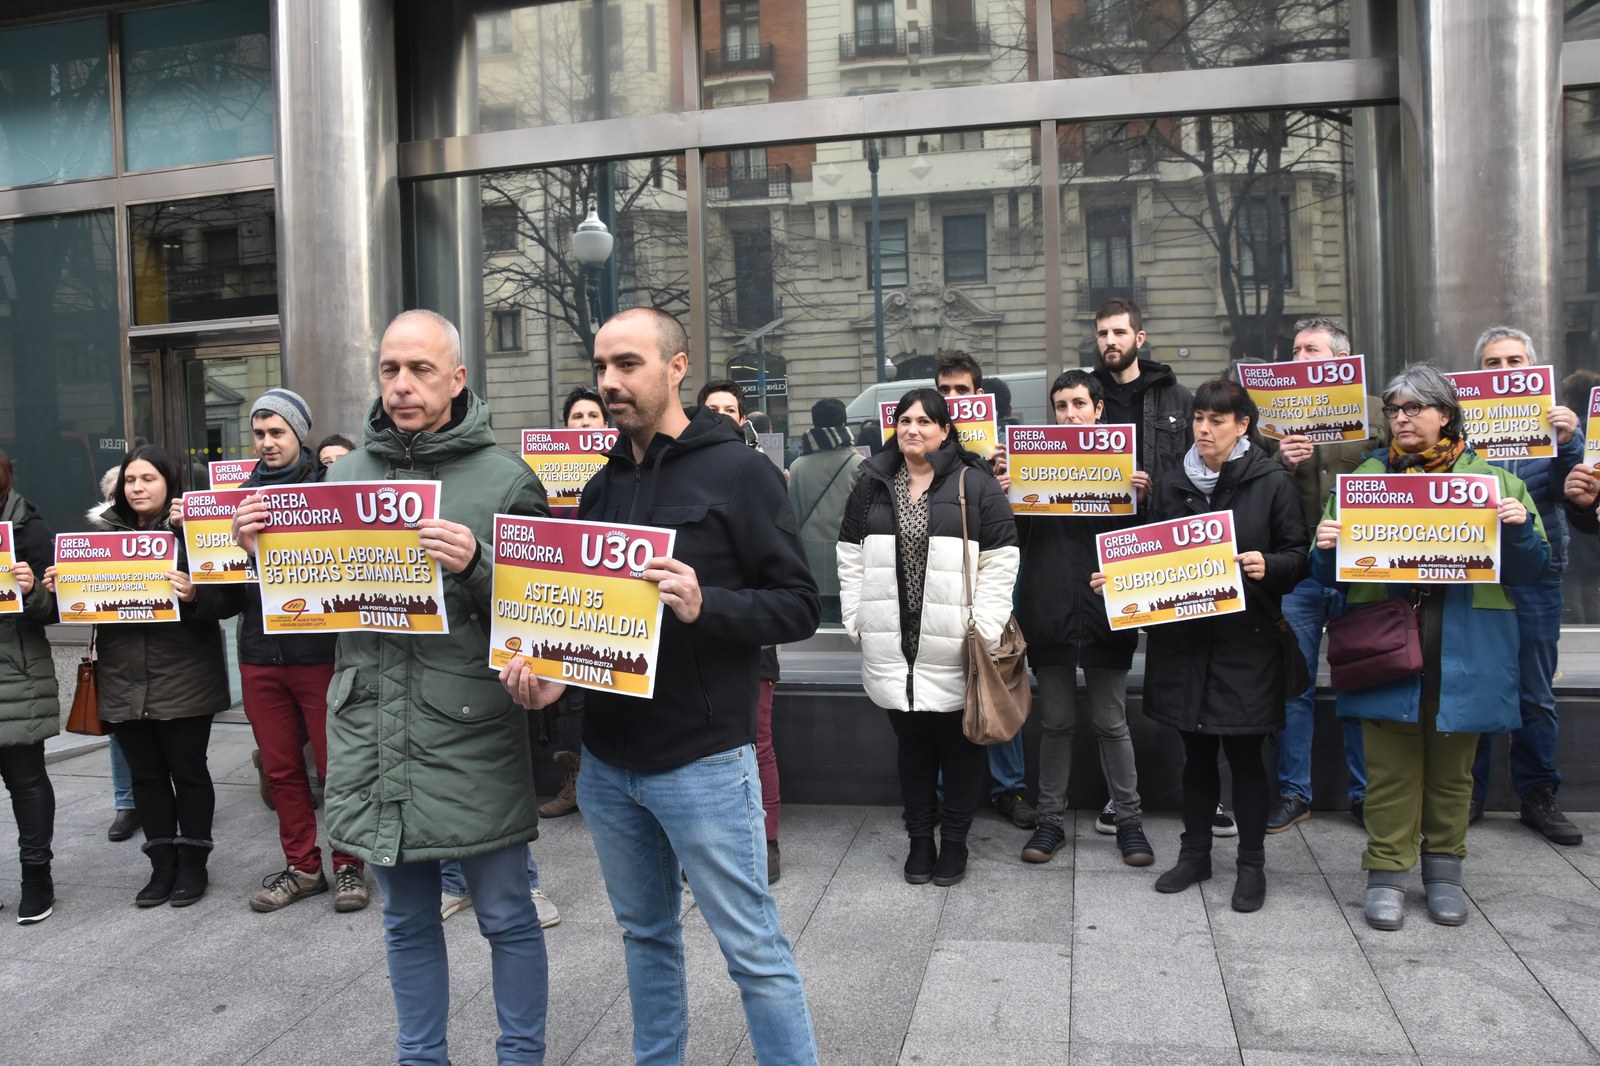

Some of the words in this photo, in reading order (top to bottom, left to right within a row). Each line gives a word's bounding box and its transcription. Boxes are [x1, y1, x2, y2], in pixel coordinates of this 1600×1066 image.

[1244, 368, 1274, 378] GREBA
[1308, 363, 1354, 384] U30
[1246, 376, 1296, 388] OROKORRA
[1493, 373, 1543, 394] U30
[1456, 387, 1480, 396] ORRA
[1271, 396, 1312, 408] ASTEAN
[1315, 394, 1329, 405] 35
[1258, 406, 1302, 419] RDUTAKO
[1306, 404, 1360, 418] LANALDIA
[1488, 403, 1541, 419] MÍNIMO
[1463, 421, 1489, 434] 200
[1493, 418, 1539, 433] EUROS
[527, 434, 552, 442] GREBA
[580, 434, 618, 451] U30
[1013, 430, 1046, 441] GREBA
[1078, 431, 1126, 450] U30
[527, 443, 570, 452] OROKORRA
[1013, 441, 1068, 451] OROKORRA
[1488, 447, 1528, 457] DUINA
[538, 463, 561, 472] 1.200
[1020, 467, 1122, 481] SUBROGAZIOA
[216, 472, 252, 481] OROKOR
[538, 472, 580, 481] TXIENEKO
[1346, 480, 1386, 492] GREBA
[1429, 482, 1488, 504] U30
[188, 496, 216, 506] GREBA
[262, 493, 308, 510] GREBA
[1346, 492, 1414, 504] OROKORRA
[188, 506, 237, 516] OROKORRA
[356, 492, 422, 523] U30
[1072, 503, 1110, 512] DUINA
[264, 508, 342, 527] OROKORRA
[500, 524, 535, 543] GREBA
[1173, 519, 1223, 546] U30
[1351, 521, 1485, 542] SUBROGACIÓN
[61, 538, 90, 548] GREBA
[122, 538, 167, 557] U30
[1104, 533, 1138, 548] GREBA
[60, 548, 111, 559] OROKORRA
[264, 546, 335, 566] JORNADA
[339, 546, 404, 564] LABORAL
[408, 549, 427, 564] DE
[499, 542, 563, 564] OROKORRA
[581, 533, 653, 572] U30
[1106, 540, 1162, 559] OROKORRA
[60, 574, 91, 583] JORNADA
[94, 572, 122, 582] MÍNIMA
[123, 574, 132, 582] DE
[134, 573, 143, 581] 20
[145, 572, 168, 581] HORA
[266, 567, 283, 583] 35
[289, 565, 341, 582] HORAS
[347, 566, 431, 583] SEMANALES
[1113, 557, 1226, 592] SUBROGACIÓN
[1418, 568, 1466, 579] DUINA
[524, 582, 581, 606] ASTEAN
[584, 590, 603, 609] 35
[118, 610, 154, 620] DUINA
[1175, 602, 1216, 617] DUINA
[360, 611, 409, 628] DUINA
[497, 599, 566, 627] ORDUTAKO
[569, 609, 648, 639] LANALDIA
[562, 662, 613, 686] DUINA
